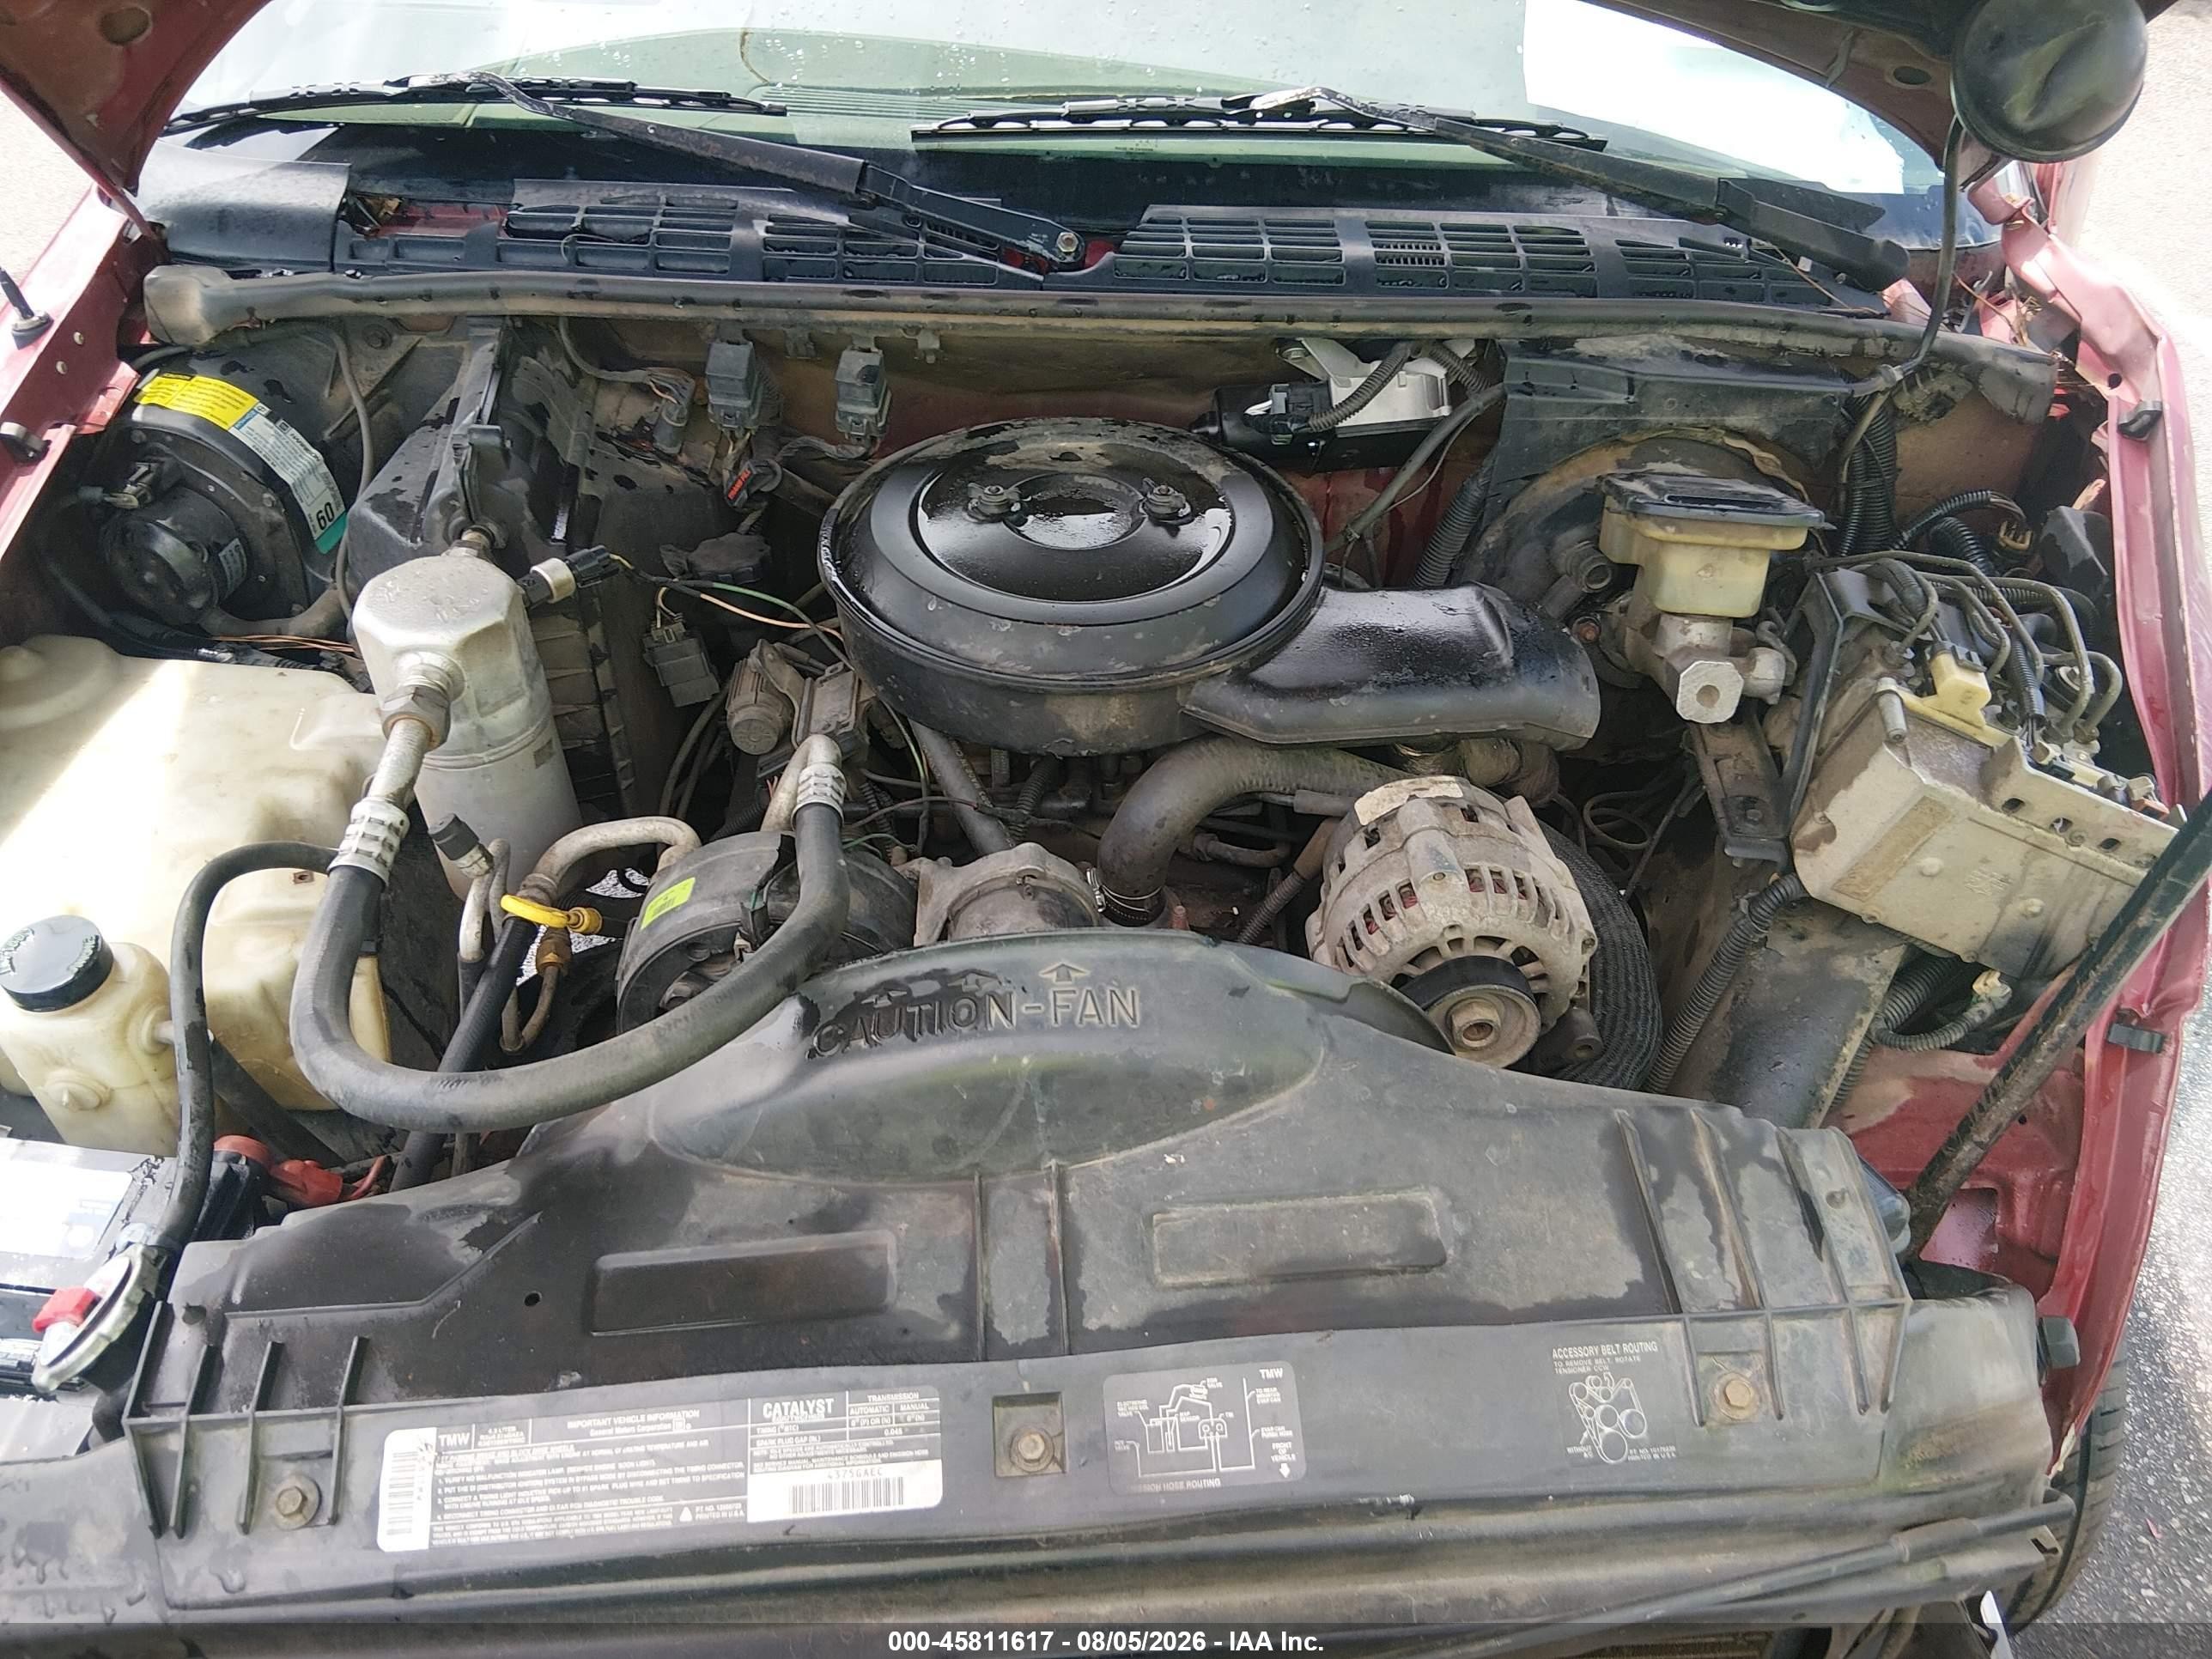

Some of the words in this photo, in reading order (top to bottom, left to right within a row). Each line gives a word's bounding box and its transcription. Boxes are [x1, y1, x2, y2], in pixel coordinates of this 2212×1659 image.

[315, 502, 336, 532] 60
[812, 988, 1141, 1058] CAUTION-FAN
[1553, 1345, 1599, 1360] ACCESSORY
[1601, 1343, 1620, 1356] BELT
[1623, 1340, 1658, 1354] ROUTING
[1565, 1358, 1593, 1367] REMOVE
[1259, 1367, 1284, 1380] TMW
[867, 1391, 920, 1403] TRANSMISSION
[763, 1397, 835, 1419] CATALYST
[849, 1405, 890, 1416] AUTOMATIC
[900, 1401, 930, 1413] MANUAL
[568, 1418, 611, 1431] IMPORTANT
[613, 1414, 646, 1426] VEHICLE
[439, 1432, 471, 1448] TMW
[1187, 1478, 1221, 1490] ROUTING
